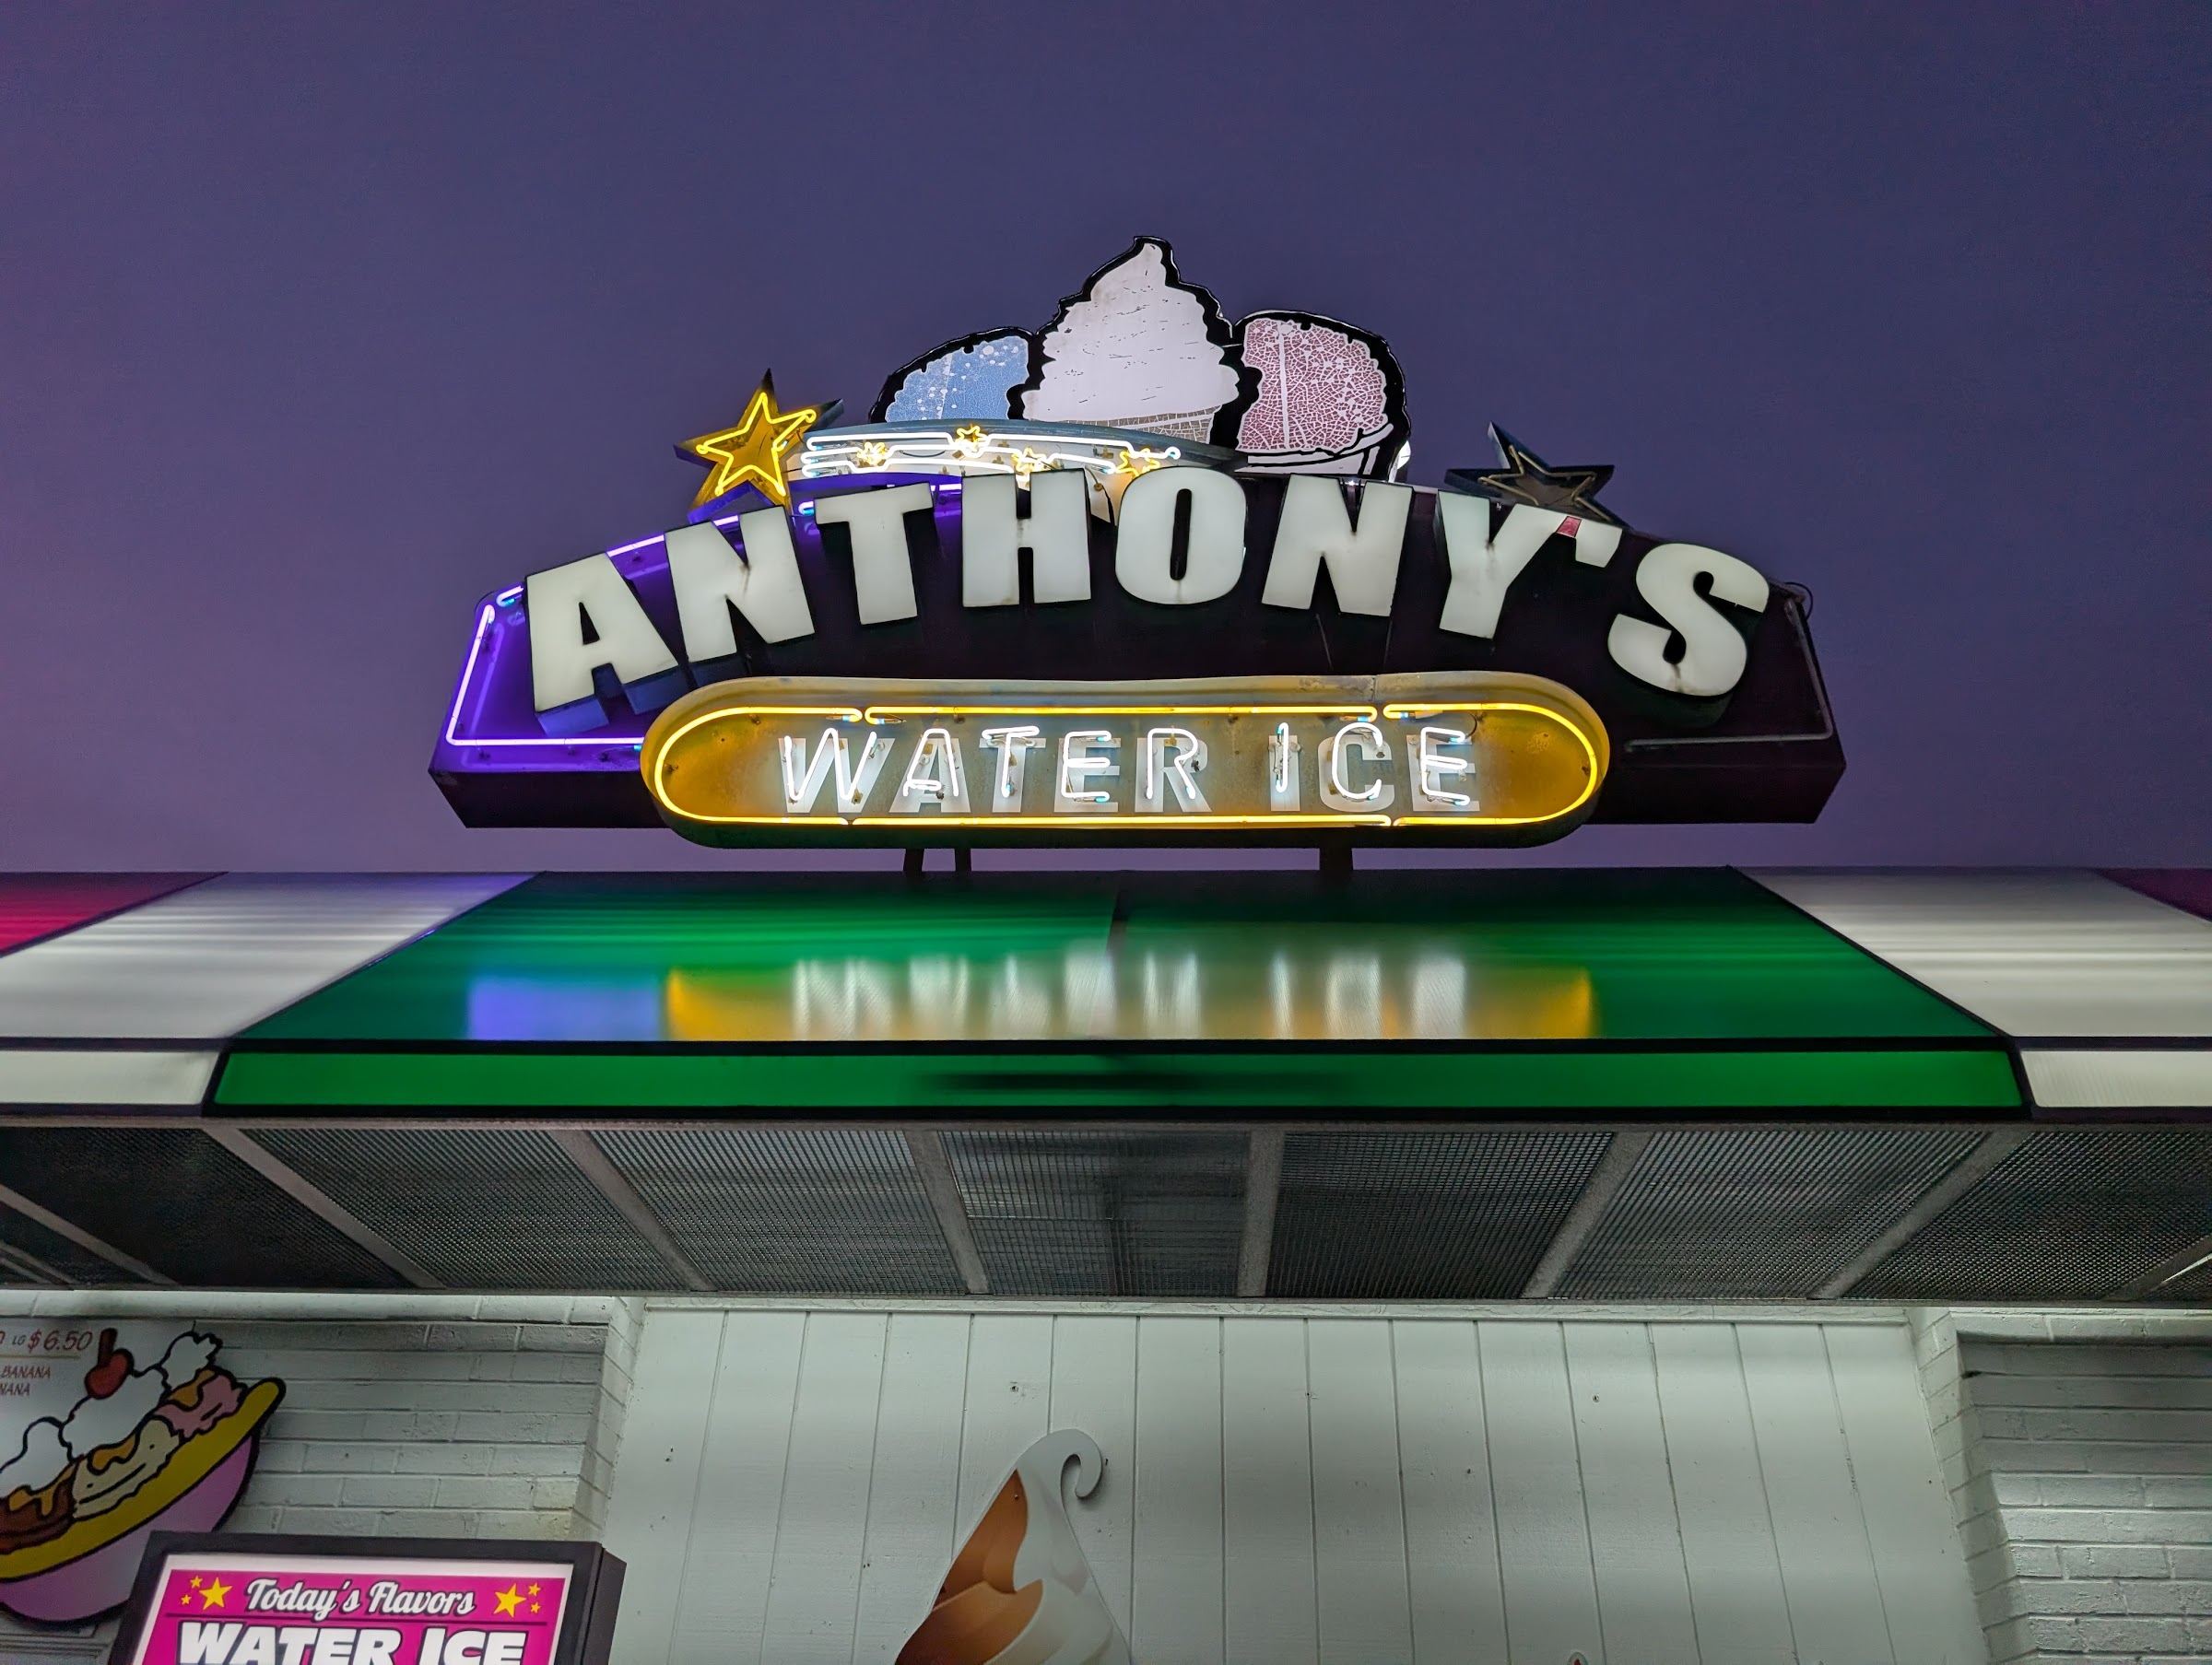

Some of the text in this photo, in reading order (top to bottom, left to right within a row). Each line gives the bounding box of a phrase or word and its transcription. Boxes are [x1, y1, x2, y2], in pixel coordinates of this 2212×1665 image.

[524, 465, 1770, 714] ANTHONY'S
[779, 722, 1480, 814] WATER ICE
[12, 1334, 26, 1345] LG
[28, 1328, 93, 1353] $6.50
[246, 1577, 477, 1622] Today's Flavors
[179, 1620, 528, 1665] WATER ICE
